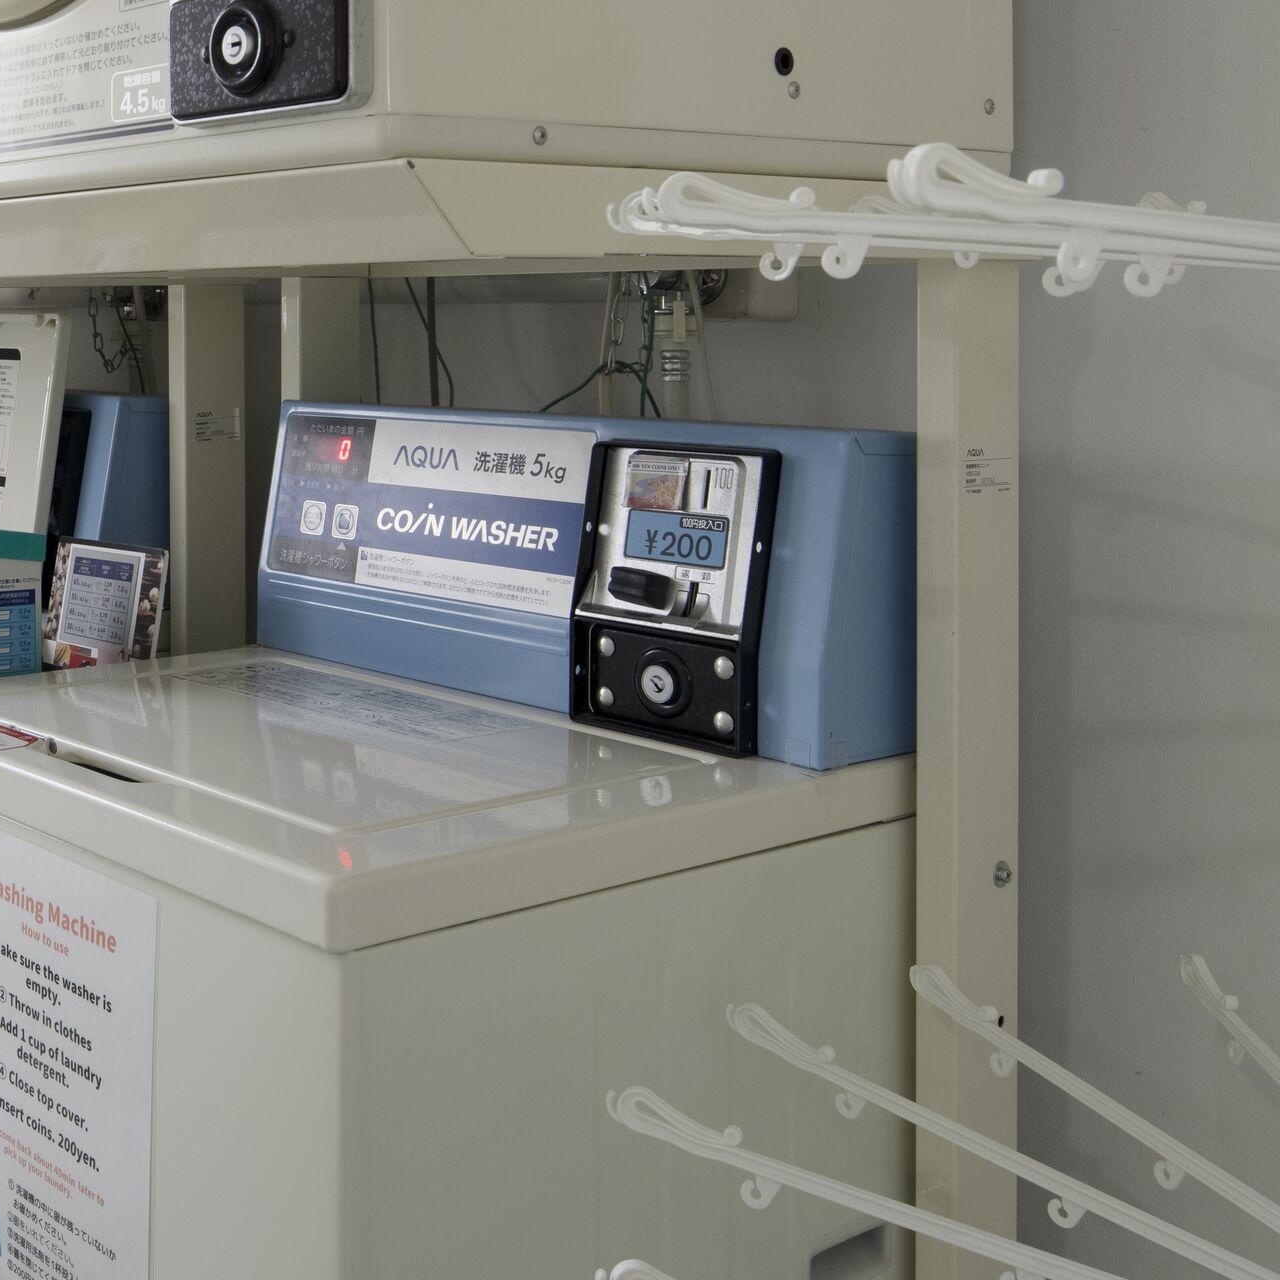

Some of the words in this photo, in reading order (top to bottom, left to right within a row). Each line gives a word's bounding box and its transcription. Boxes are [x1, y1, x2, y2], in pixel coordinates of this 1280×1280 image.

[339, 439, 351, 460] 0
[393, 445, 459, 470] AQUA
[473, 451, 526, 476] 洗濯機
[714, 467, 734, 490] 100
[451, 516, 558, 551] WASHER
[645, 528, 712, 561] ¥200
[682, 518, 723, 531] 100円投入口
[21, 922, 40, 942] How
[42, 933, 52, 947] to
[54, 941, 70, 957] use
[48, 902, 117, 953] Machine
[20, 955, 40, 974] sure
[43, 965, 60, 985] the
[62, 977, 100, 1006] washer
[103, 994, 112, 1013] is
[26, 977, 61, 1006] empty.
[9, 992, 40, 1021] Throw
[42, 1010, 52, 1028] in
[54, 1020, 92, 1051] clothes
[0, 1017, 18, 1037] Add
[21, 1029, 25, 1042] 1
[28, 1035, 46, 1056] cup
[48, 1048, 59, 1061] of
[61, 1051, 102, 1090] laundry
[17, 1046, 70, 1088] detergent.
[9, 1070, 35, 1097] Close
[37, 1088, 54, 1111] top
[56, 1102, 88, 1132] cover.
[26, 1115, 55, 1143] coins.
[58, 1133, 99, 1172] 200yen.
[0, 1130, 16, 1146] come
[17, 1139, 32, 1157] back
[33, 1152, 53, 1172] about
[54, 1166, 76, 1187] 40min
[78, 1181, 96, 1200] later
[97, 1196, 105, 1206] to
[4, 1146, 18, 1160] pick
[18, 1158, 27, 1168] up
[28, 1163, 44, 1177] your
[44, 1171, 73, 1199] laundry.
[13, 1199, 67, 1246] お確かめください。
